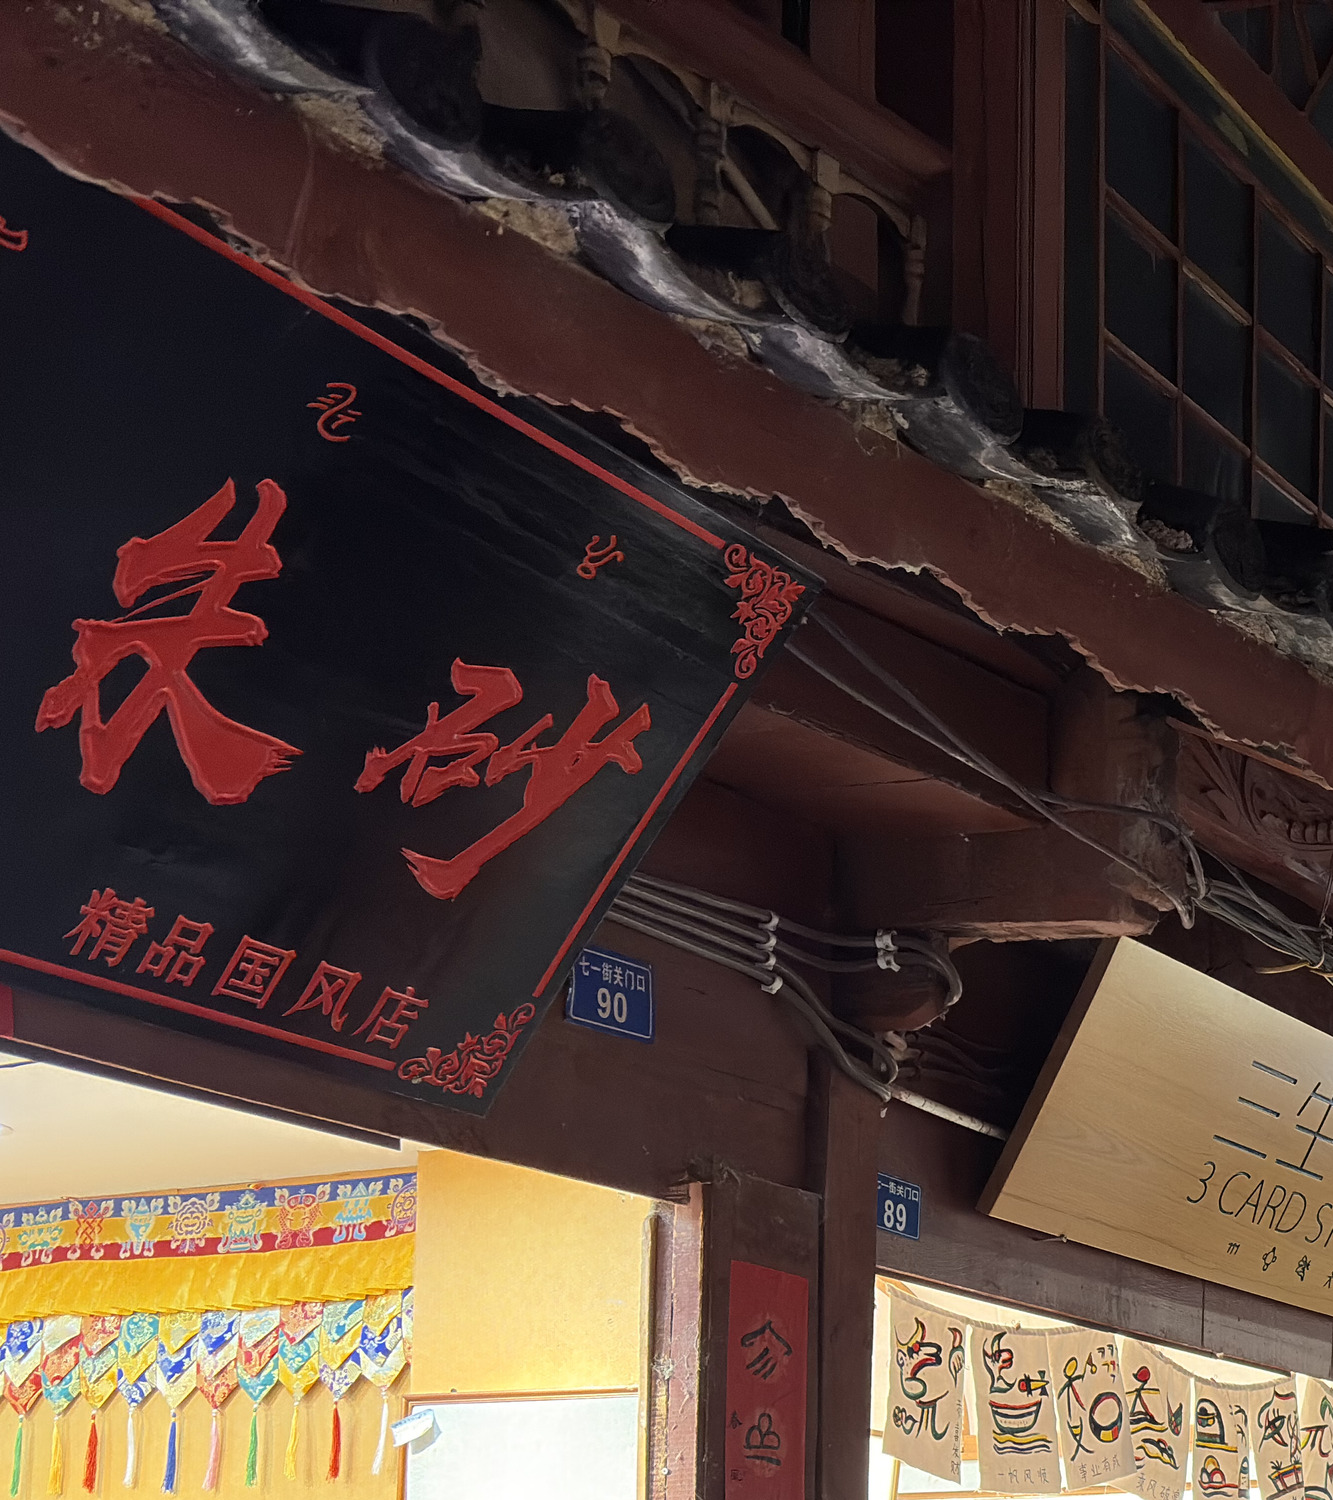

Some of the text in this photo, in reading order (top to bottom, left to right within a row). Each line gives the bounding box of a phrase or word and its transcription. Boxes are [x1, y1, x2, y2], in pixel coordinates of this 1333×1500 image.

[63, 886, 430, 1052] 精品国风店
[578, 954, 646, 993] 七一街关门口
[596, 987, 628, 1024] 90
[883, 1199, 907, 1232] 89
[1186, 1160, 1217, 1205] 3
[1217, 1171, 1307, 1234] CARD
[997, 1467, 1050, 1484] 一帆风顺
